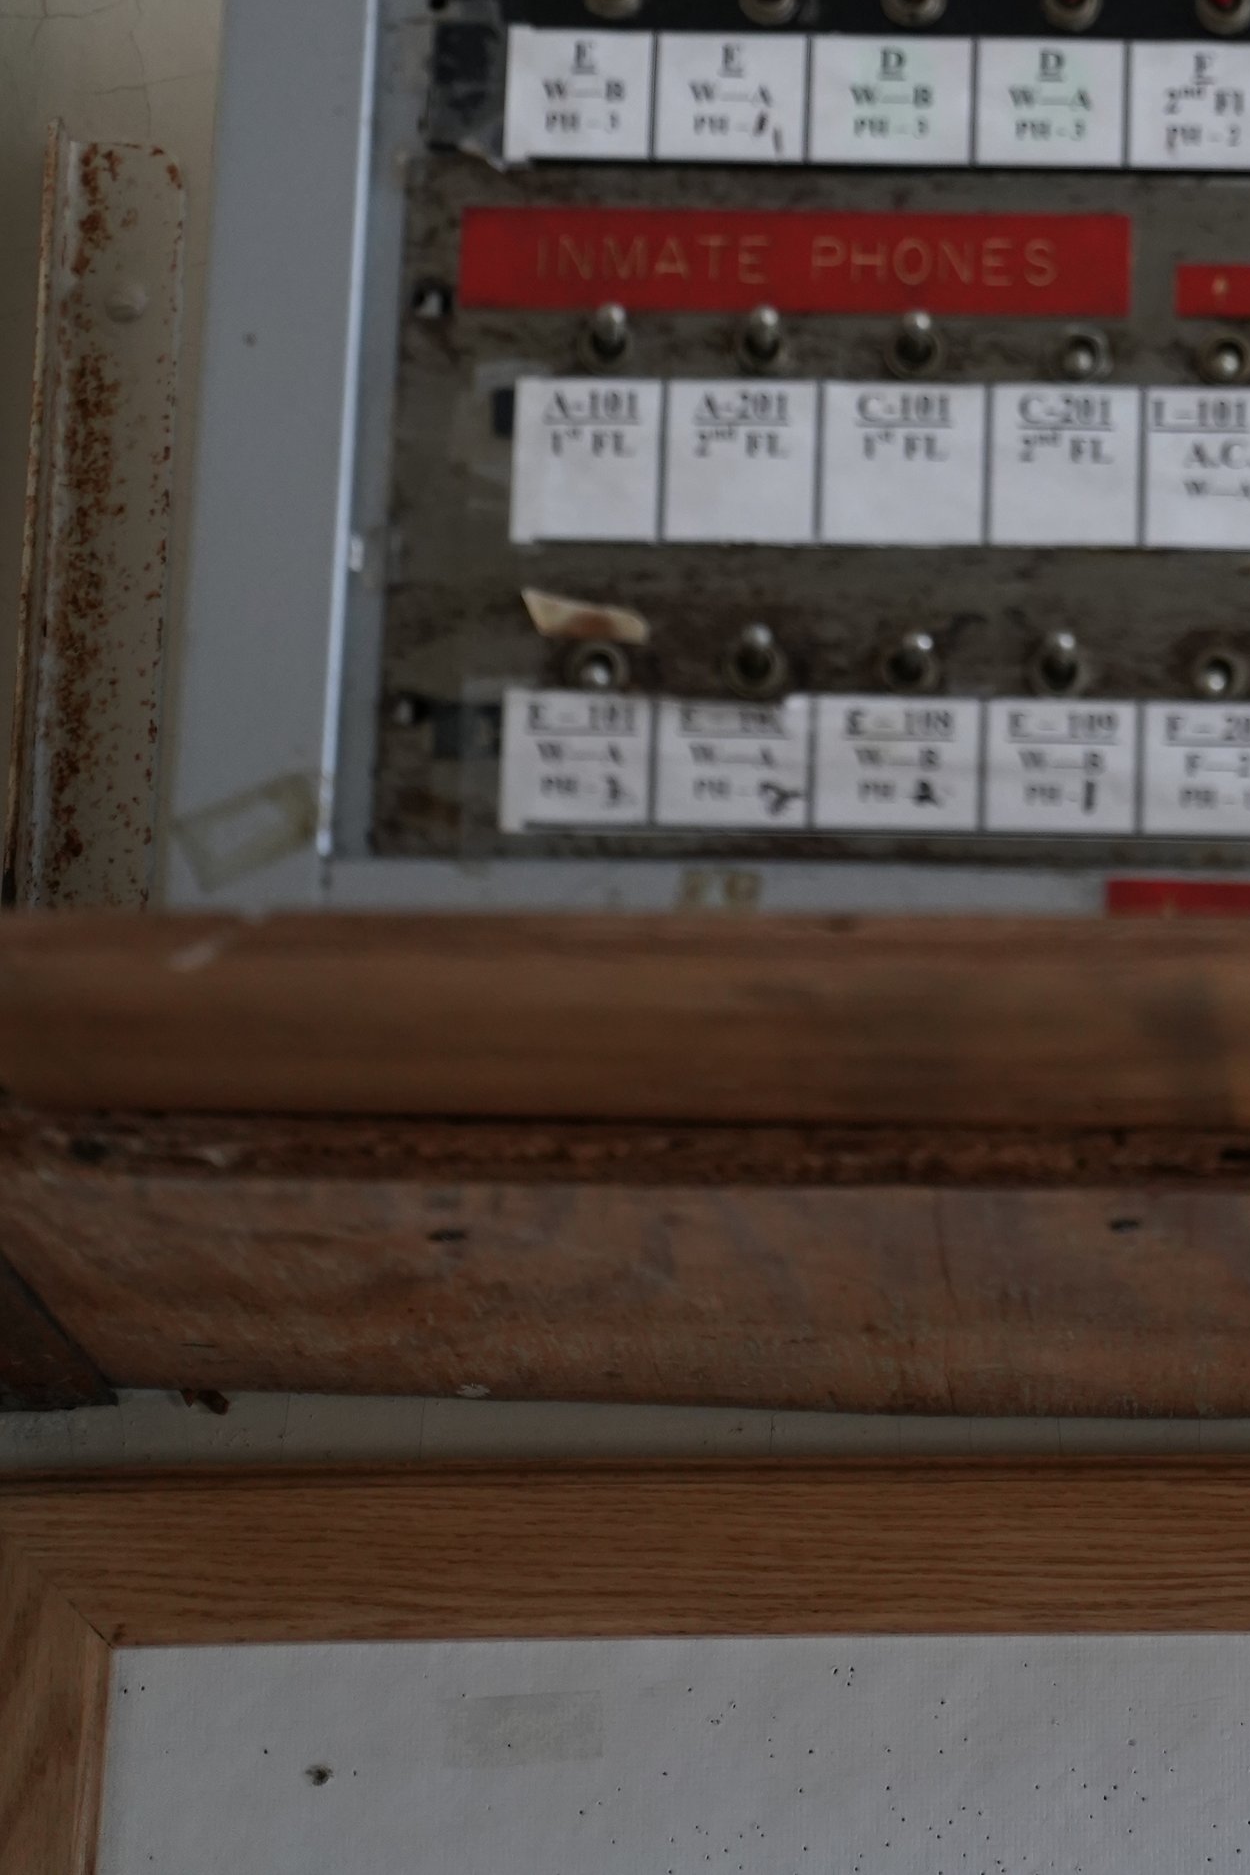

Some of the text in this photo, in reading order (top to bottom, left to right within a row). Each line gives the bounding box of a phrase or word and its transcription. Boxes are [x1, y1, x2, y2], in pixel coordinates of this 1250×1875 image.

[880, 50, 905, 80] D
[1040, 51, 1065, 81] D
[536, 236, 1059, 287] INMATE PHONES
[546, 394, 639, 422] A-101
[694, 393, 790, 423] A-201
[856, 393, 951, 424] C-101
[1019, 396, 1112, 427] C-201
